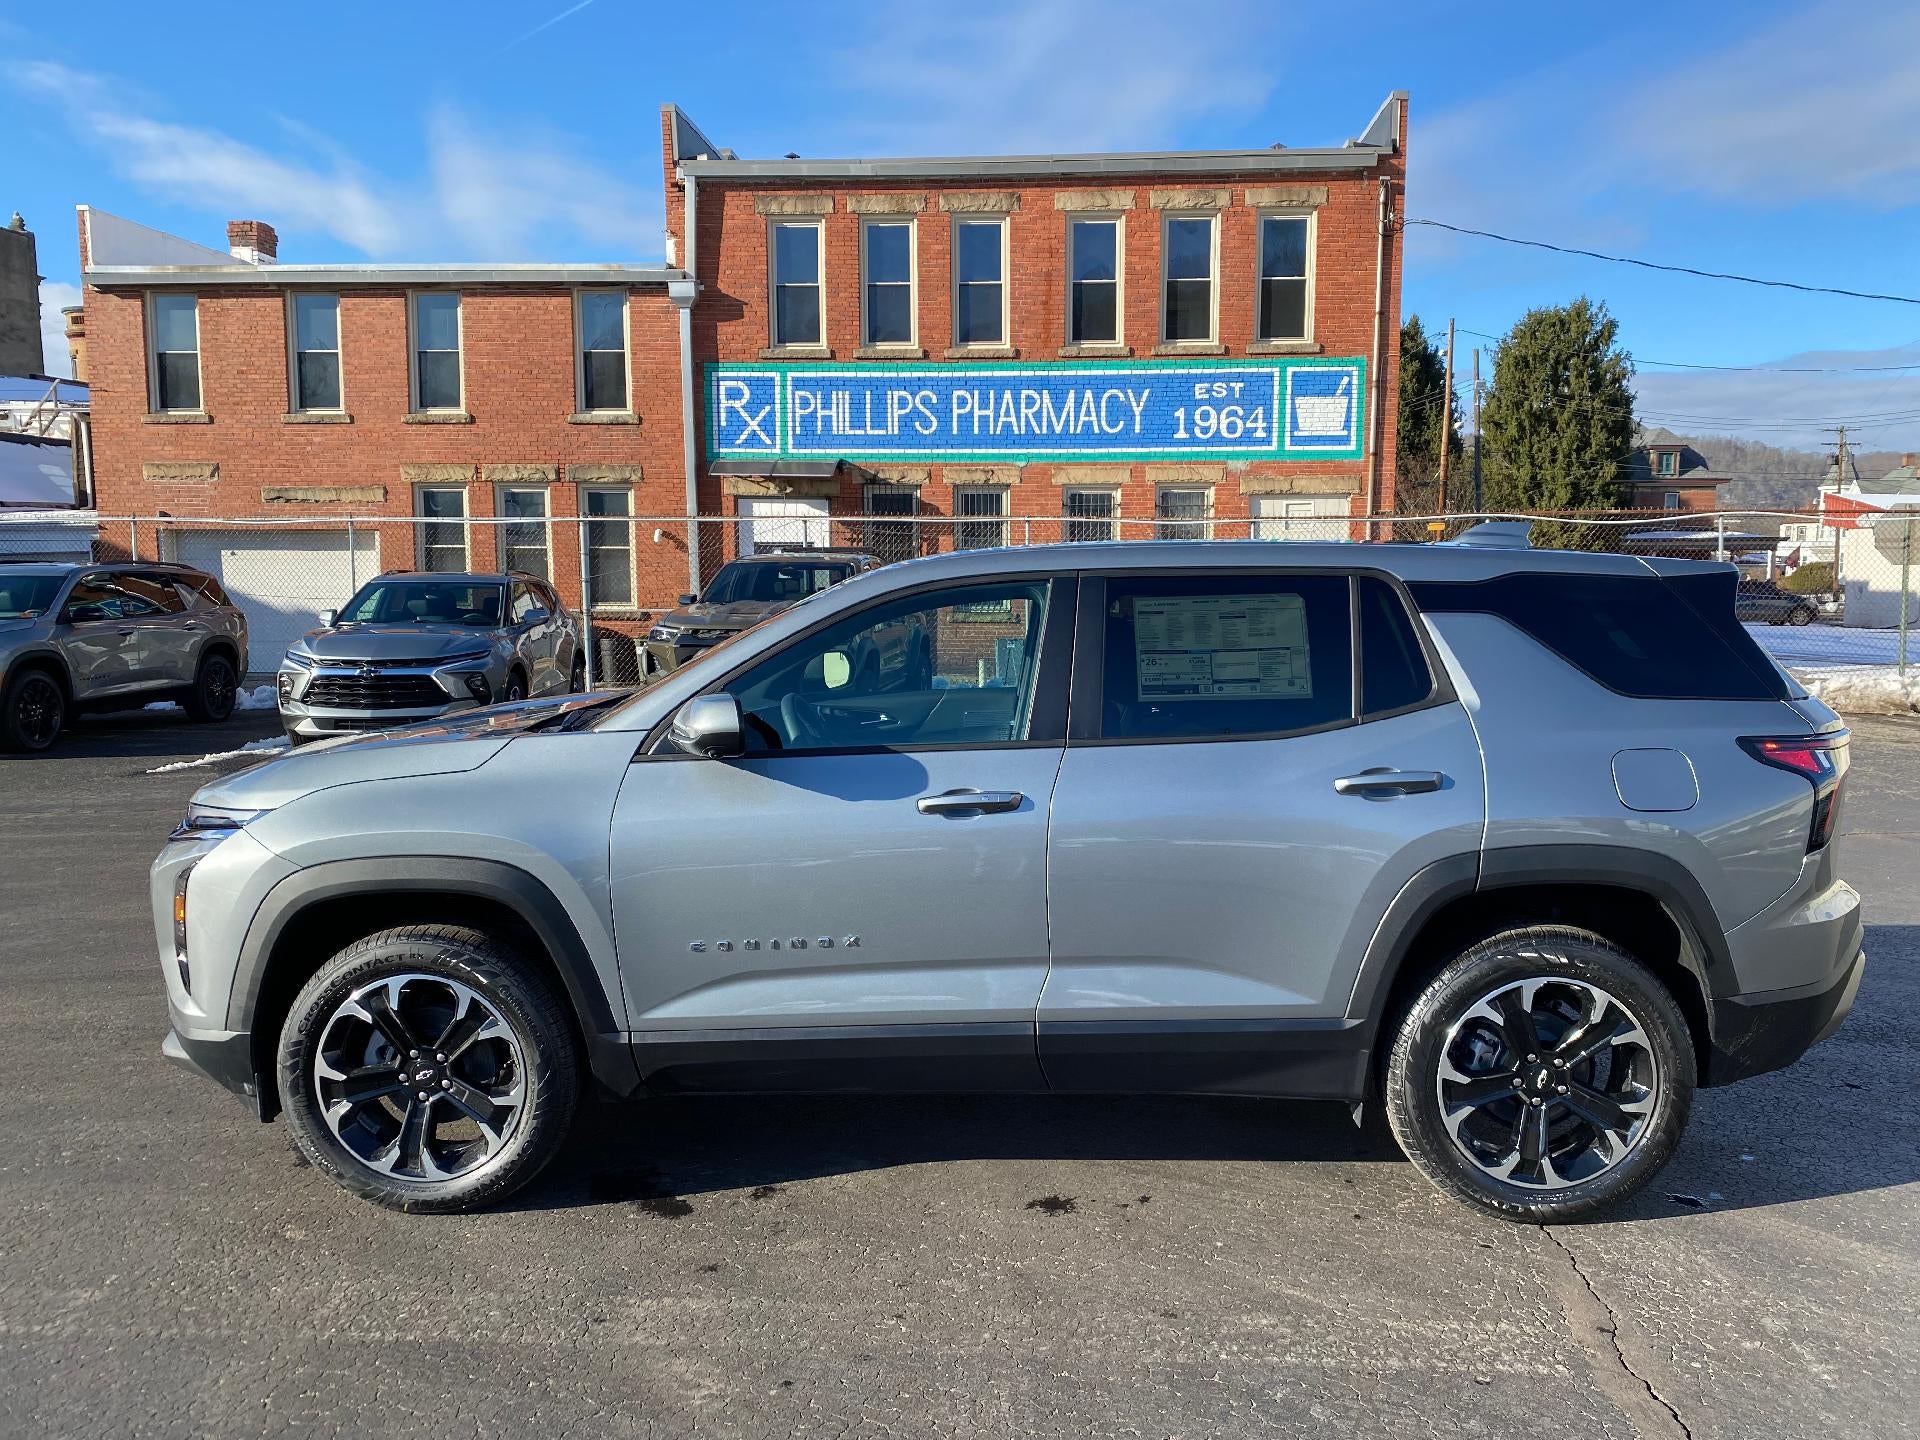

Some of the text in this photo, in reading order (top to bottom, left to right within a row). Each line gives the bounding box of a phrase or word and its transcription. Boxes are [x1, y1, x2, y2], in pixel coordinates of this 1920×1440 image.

[1194, 382, 1246, 399] EST
[794, 388, 1150, 435] PHILLIPS PHARMACY
[1173, 405, 1268, 439] 1964
[689, 934, 862, 953] EQUINOX
